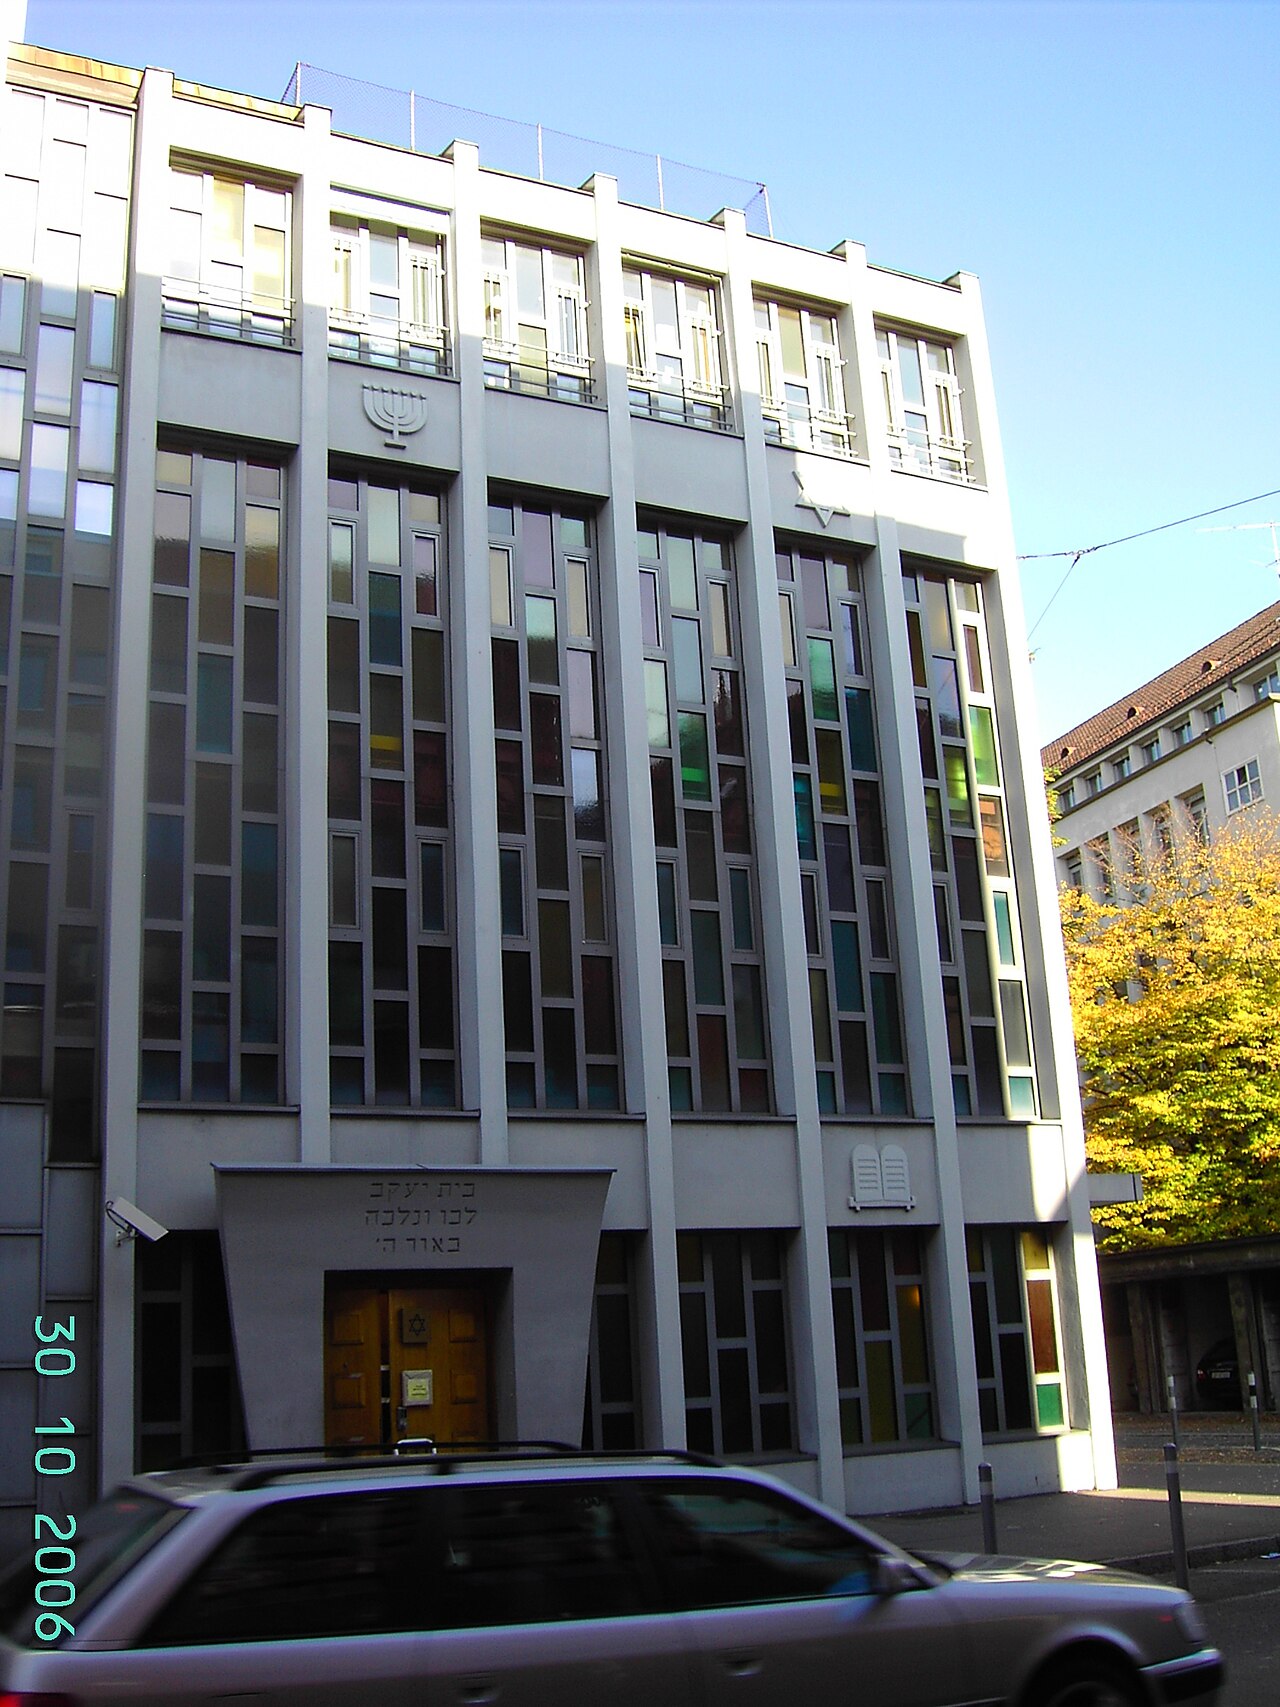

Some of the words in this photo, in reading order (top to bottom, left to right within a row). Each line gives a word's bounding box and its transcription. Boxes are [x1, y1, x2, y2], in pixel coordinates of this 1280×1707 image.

[370, 1182, 429, 1201] יעקב
[437, 1182, 475, 1198] בית
[365, 1206, 431, 1226] ונלכה
[440, 1206, 477, 1225] לכו
[406, 1237, 460, 1253] באור
